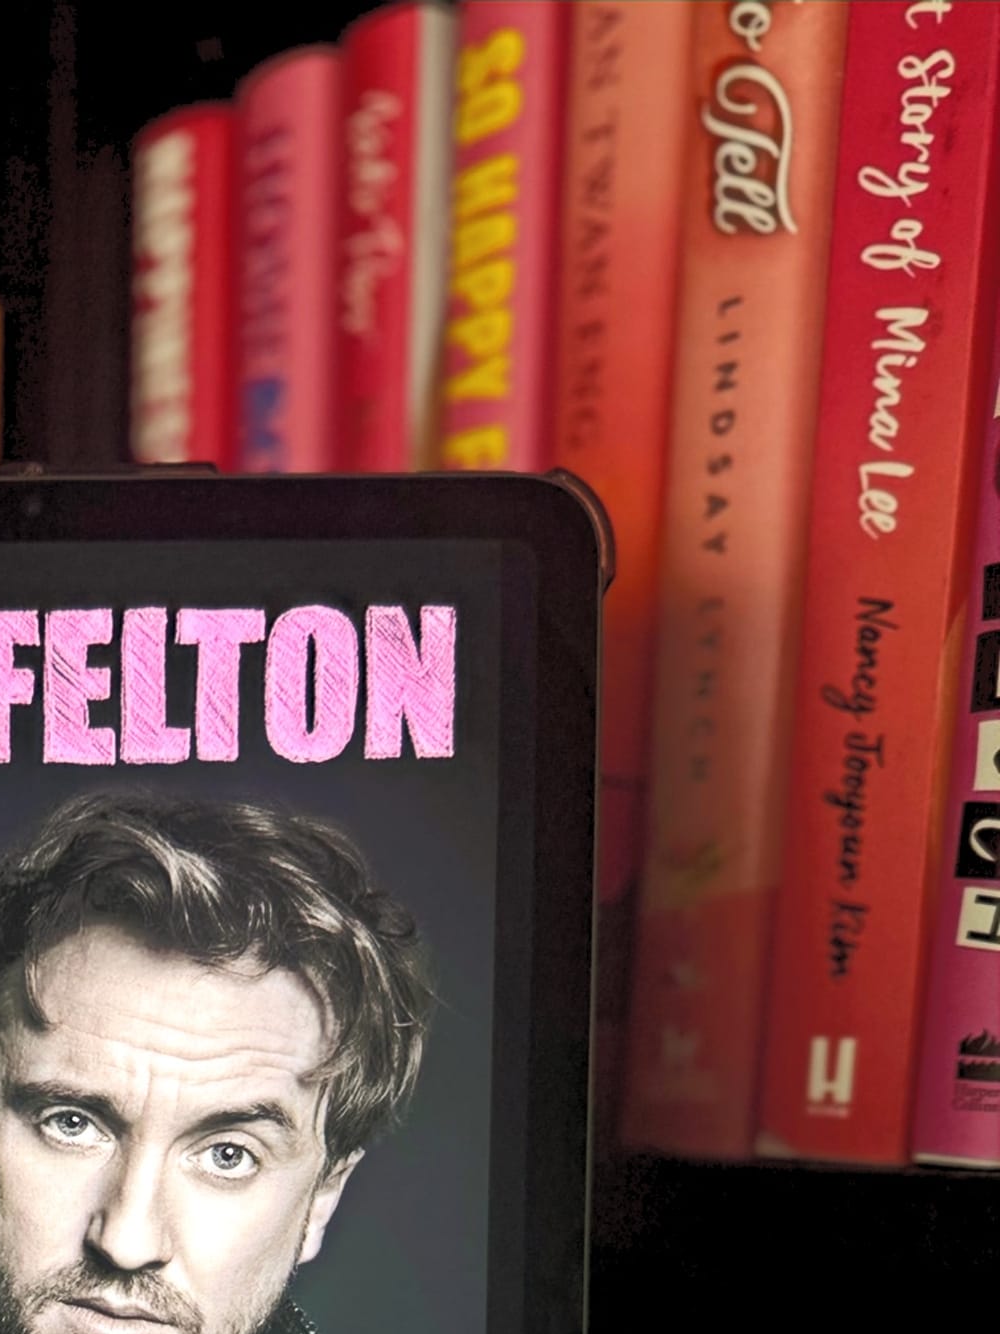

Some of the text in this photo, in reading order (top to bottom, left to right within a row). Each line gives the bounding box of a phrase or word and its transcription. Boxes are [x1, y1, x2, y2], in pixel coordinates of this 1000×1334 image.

[456, 27, 524, 145] SO
[702, 63, 798, 236] Tell
[858, 48, 956, 207] Story
[445, 153, 519, 400] HAPPY
[860, 218, 941, 278] of
[702, 294, 746, 557] LINDSAY
[869, 306, 929, 452] Mina
[859, 459, 915, 541] Lee
[820, 597, 899, 721] Nancy
[828, 899, 868, 979] Kim
